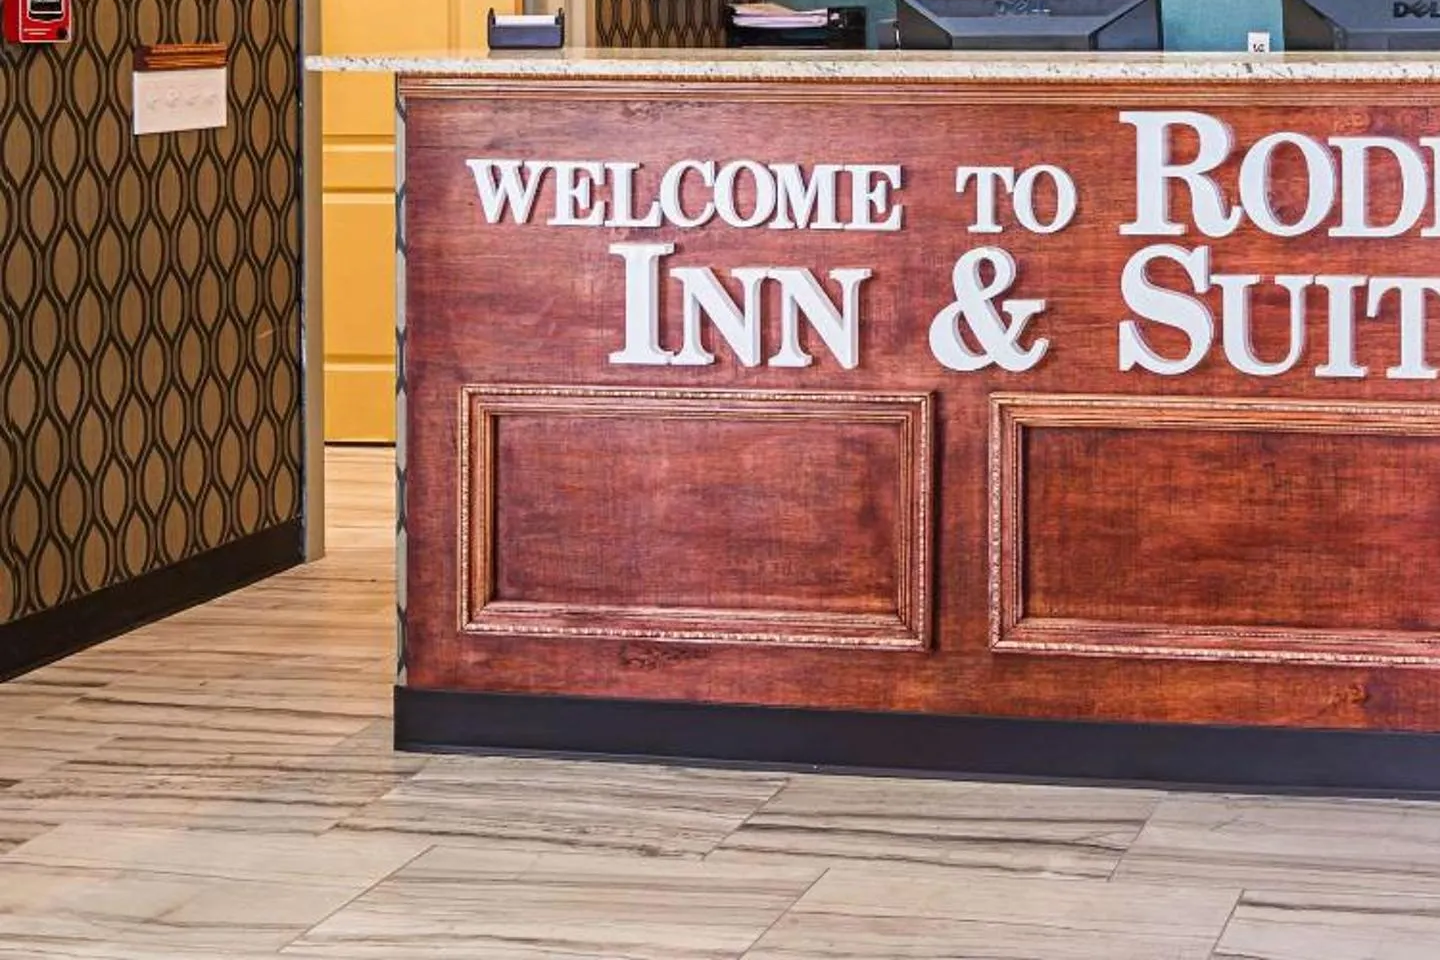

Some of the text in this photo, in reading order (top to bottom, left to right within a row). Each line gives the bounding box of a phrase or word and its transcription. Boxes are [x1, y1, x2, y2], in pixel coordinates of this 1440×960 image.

[465, 158, 905, 232] WELCOME
[955, 164, 1078, 235] TO
[608, 242, 873, 371] INN
[929, 245, 1050, 373] &
